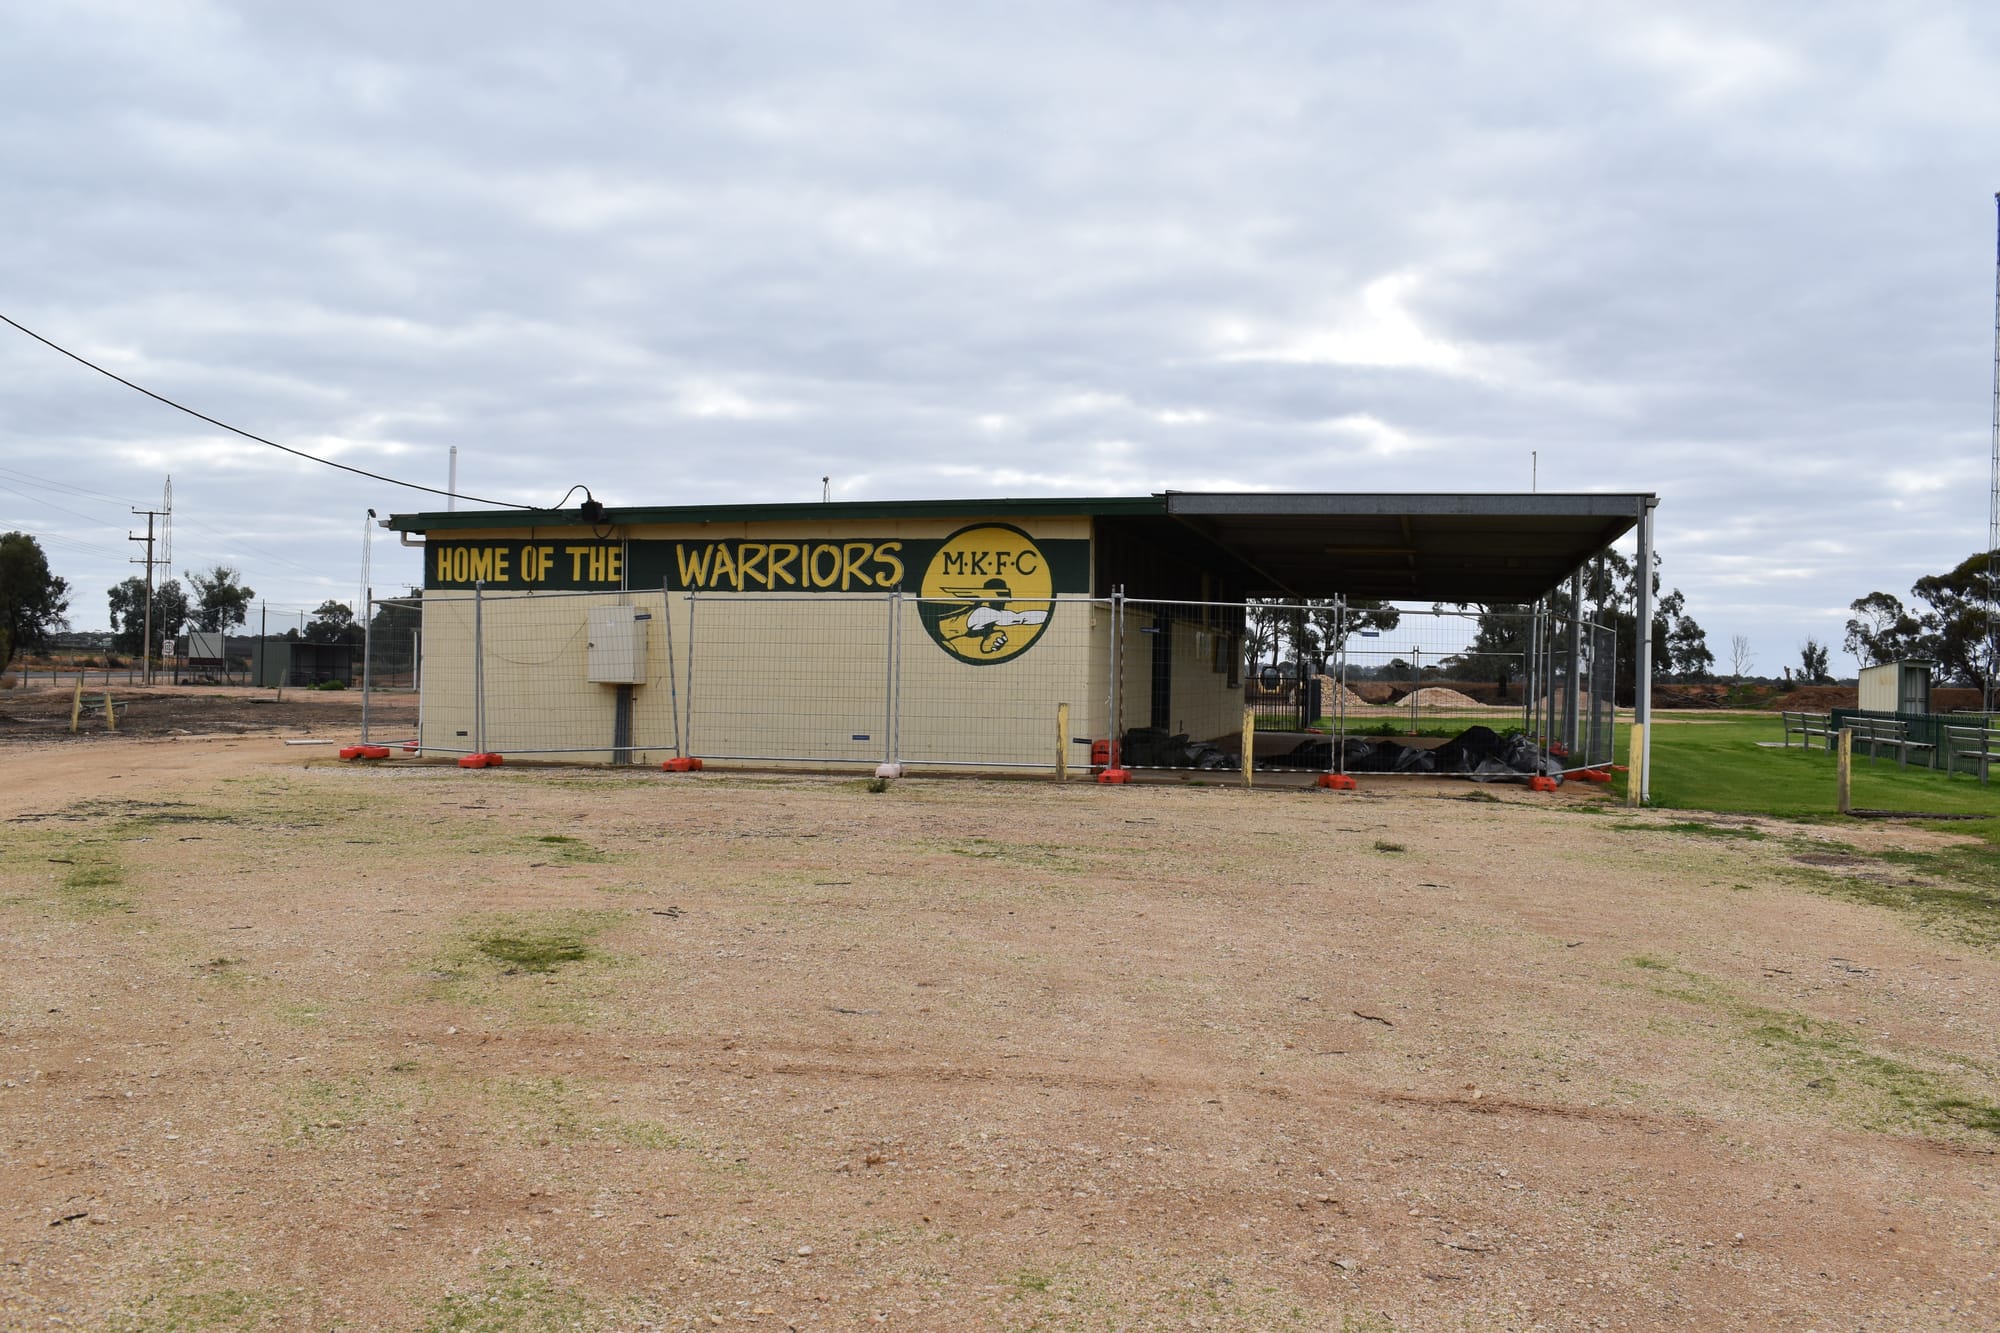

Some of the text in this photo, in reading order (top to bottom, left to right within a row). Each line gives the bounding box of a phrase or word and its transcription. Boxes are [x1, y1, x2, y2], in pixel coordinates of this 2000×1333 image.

[438, 542, 904, 591] HOME OF THE WARRIORS
